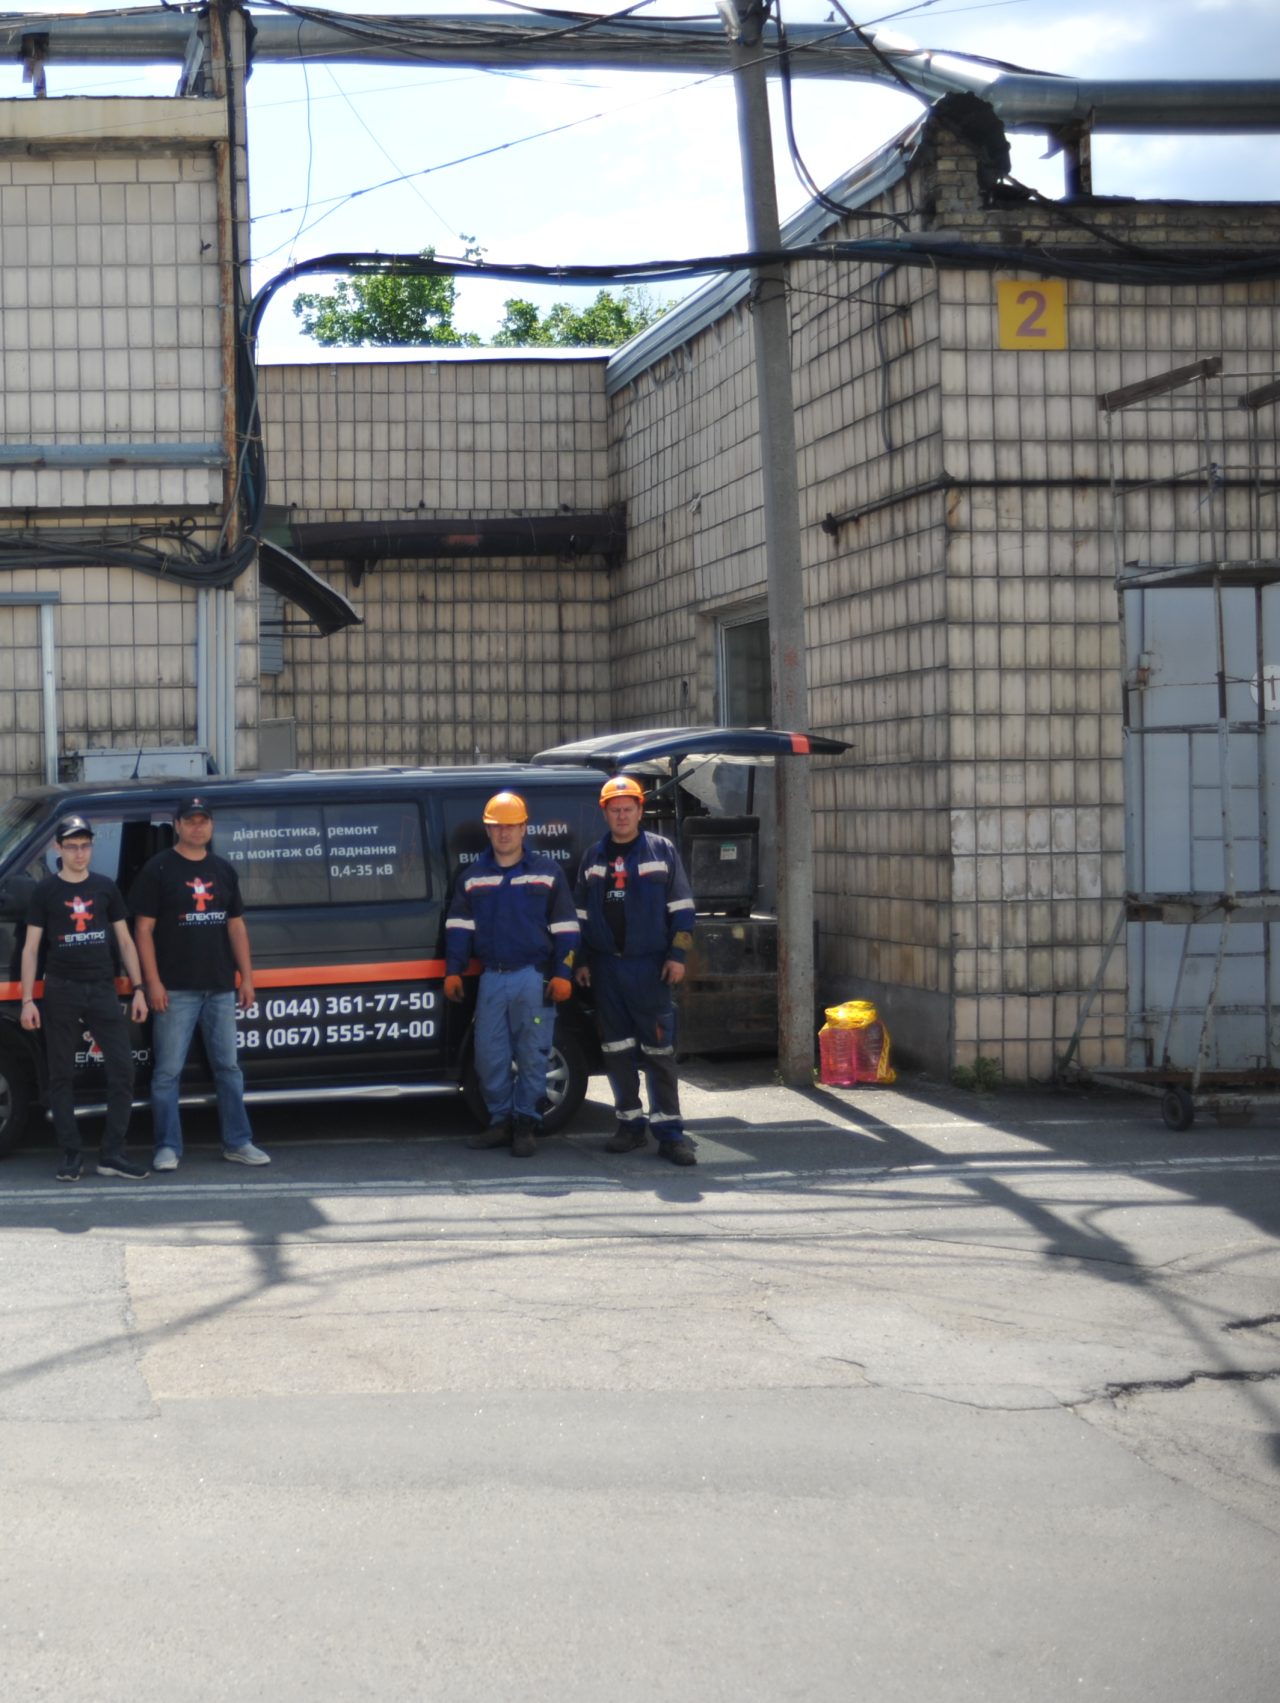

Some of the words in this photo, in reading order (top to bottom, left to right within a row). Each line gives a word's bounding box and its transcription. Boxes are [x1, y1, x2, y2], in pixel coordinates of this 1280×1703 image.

[1015, 290, 1048, 337] 2
[232, 827, 320, 841] діагностика,
[327, 825, 379, 839] ремонт
[526, 824, 568, 836] види
[227, 851, 243, 860] та
[247, 846, 302, 859] монтаж
[330, 865, 373, 878] 0,4-35
[376, 864, 394, 875] кВ
[265, 997, 319, 1021] (044)
[325, 992, 435, 1016] 361-77-50
[265, 1026, 320, 1049] (067)
[326, 1020, 435, 1043] 555-74-00
